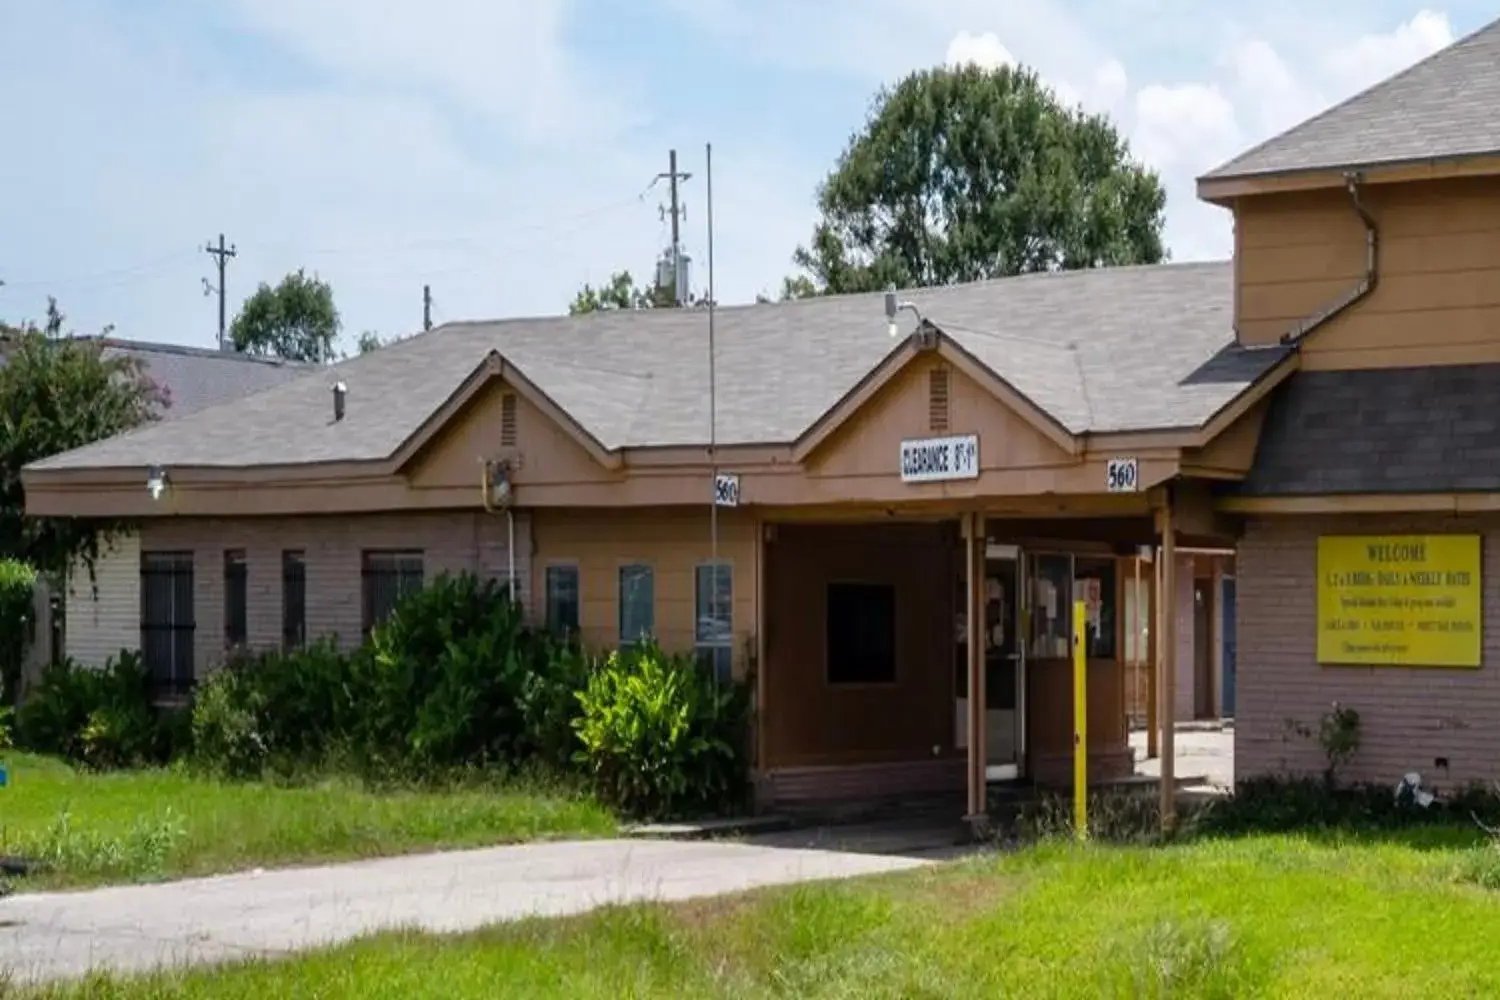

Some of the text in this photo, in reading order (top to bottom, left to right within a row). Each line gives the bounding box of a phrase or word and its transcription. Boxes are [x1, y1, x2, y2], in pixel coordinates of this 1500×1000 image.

[903, 446, 948, 475] CLEARANCE
[1110, 463, 1134, 488] 560
[1366, 543, 1426, 562] WELCOME
